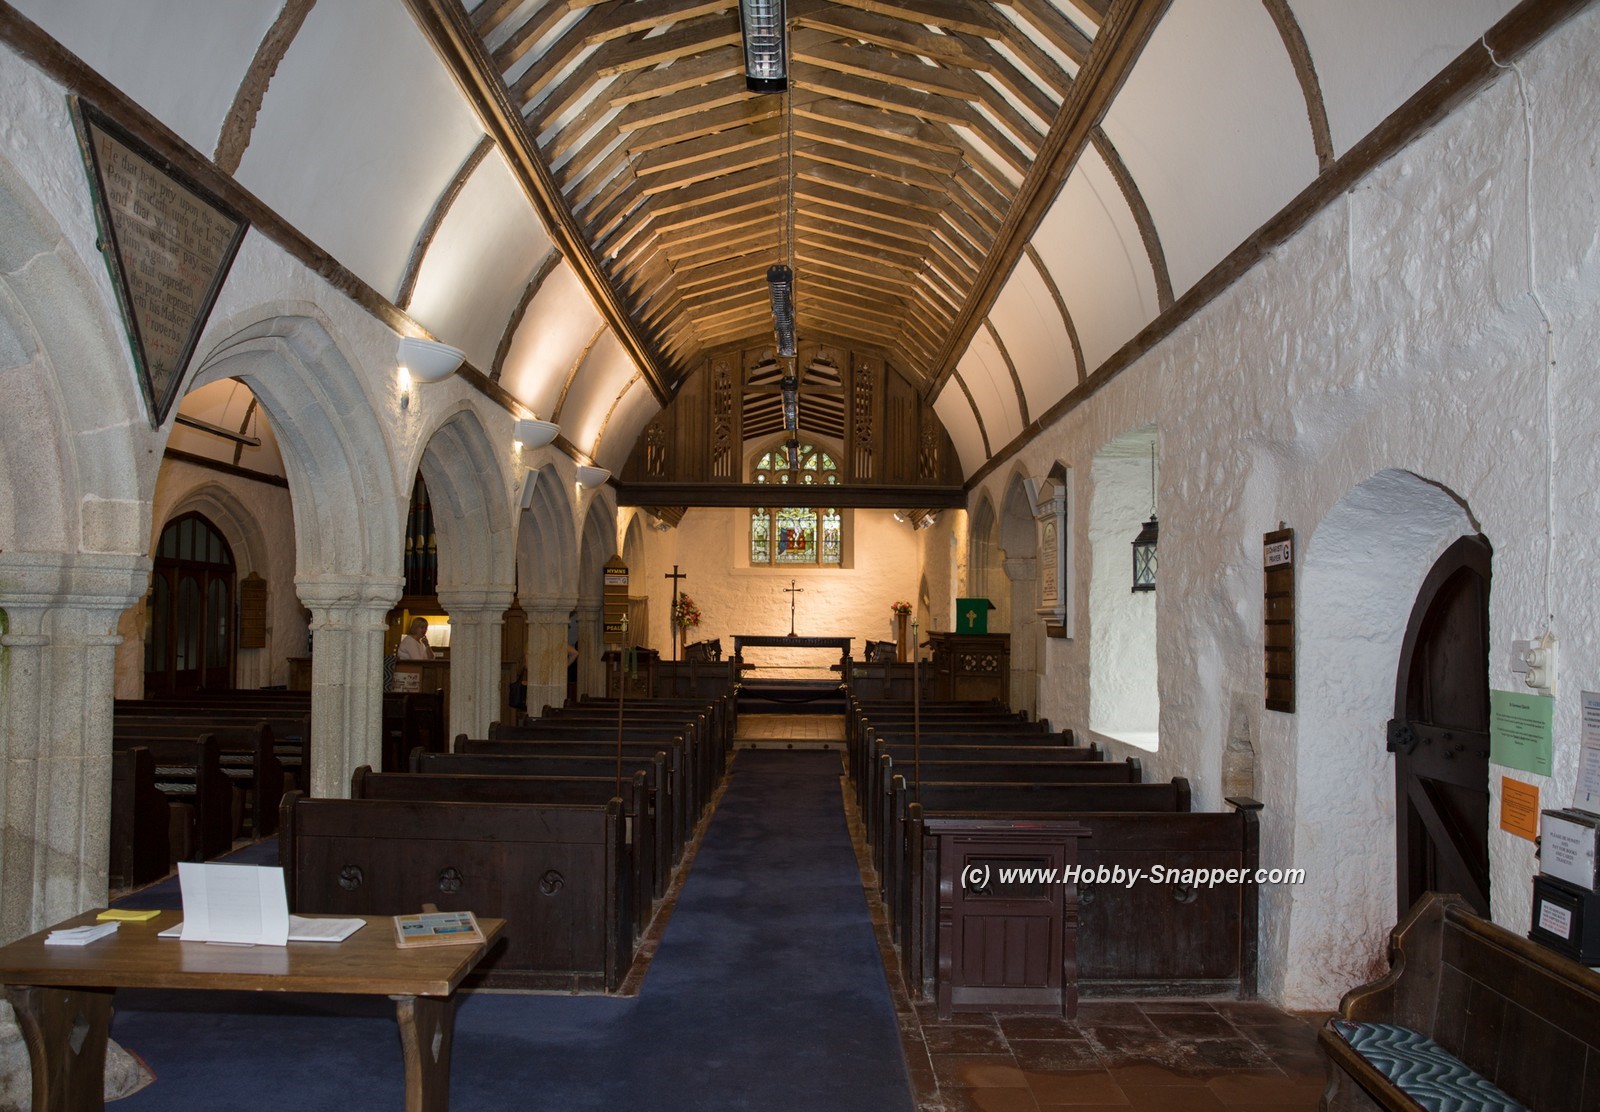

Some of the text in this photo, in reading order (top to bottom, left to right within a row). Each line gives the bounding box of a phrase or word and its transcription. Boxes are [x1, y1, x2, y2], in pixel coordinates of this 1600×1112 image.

[102, 136, 213, 226] He that hath pity upon the
[110, 191, 128, 207] and
[133, 199, 150, 221] that
[153, 214, 181, 241] which
[183, 229, 195, 248] he
[172, 209, 189, 227] unto
[191, 218, 204, 237] the
[124, 249, 138, 269] He
[140, 258, 155, 278] that
[169, 241, 180, 256] he
[183, 252, 198, 270] pay
[130, 270, 142, 288] the
[133, 292, 147, 309] eth
[149, 297, 160, 316] his
[1283, 544, 1290, 560] G
